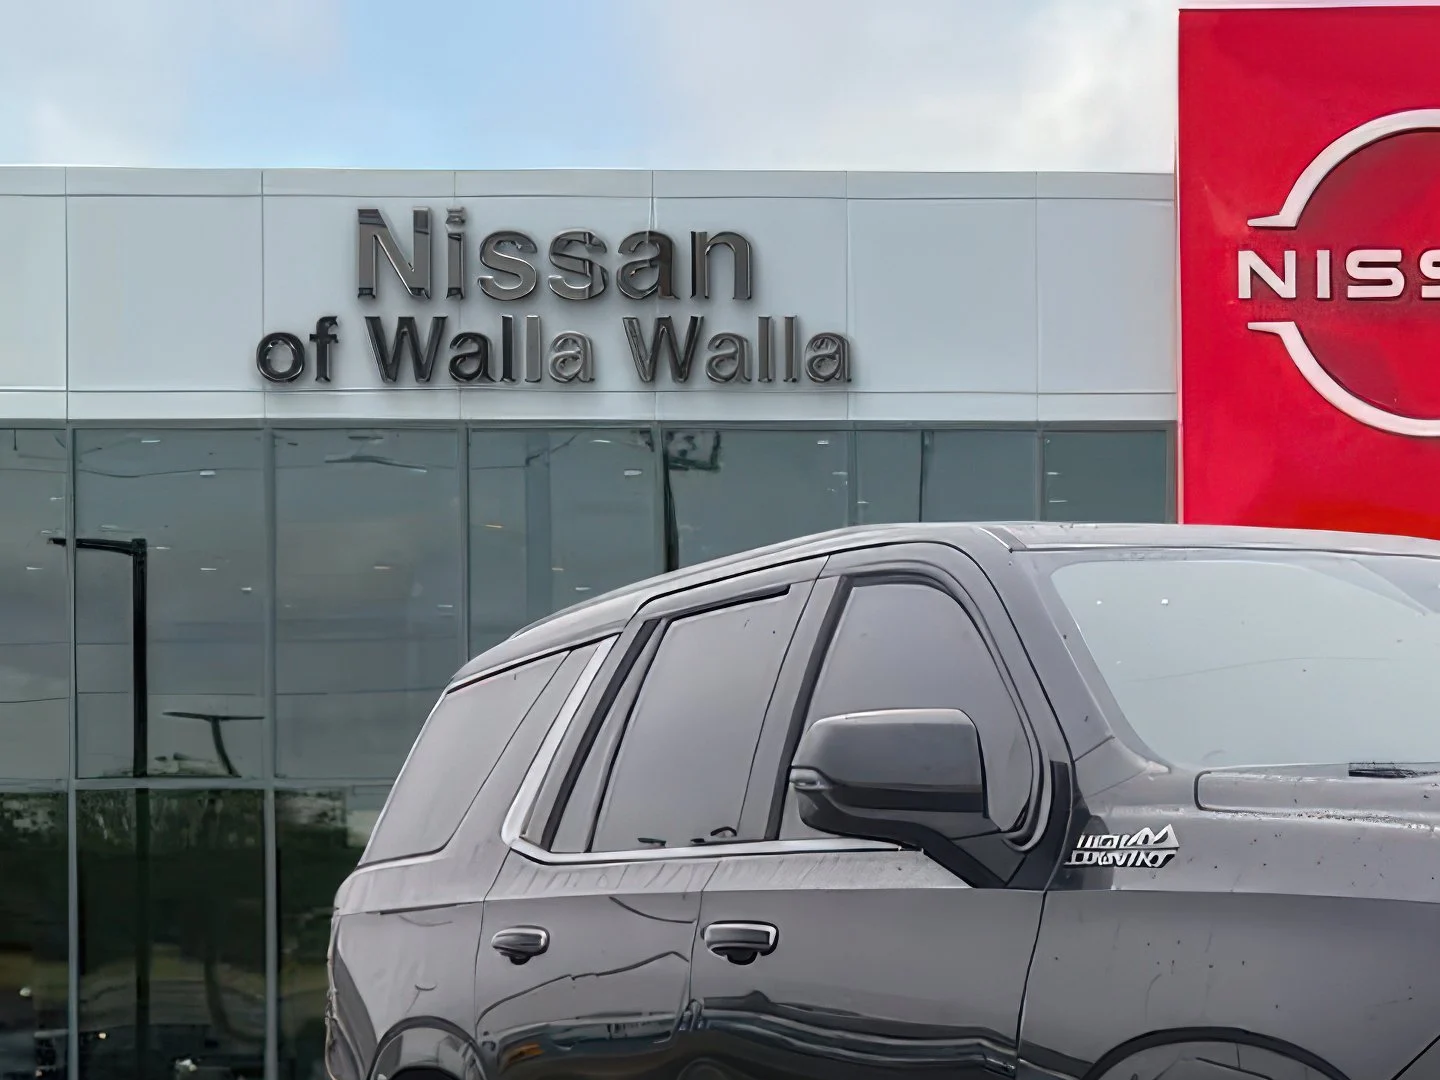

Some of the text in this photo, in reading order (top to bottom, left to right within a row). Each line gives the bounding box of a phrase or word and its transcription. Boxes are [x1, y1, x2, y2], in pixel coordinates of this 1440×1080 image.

[356, 206, 755, 300] Nissan
[255, 315, 852, 383] of Walla Walla
